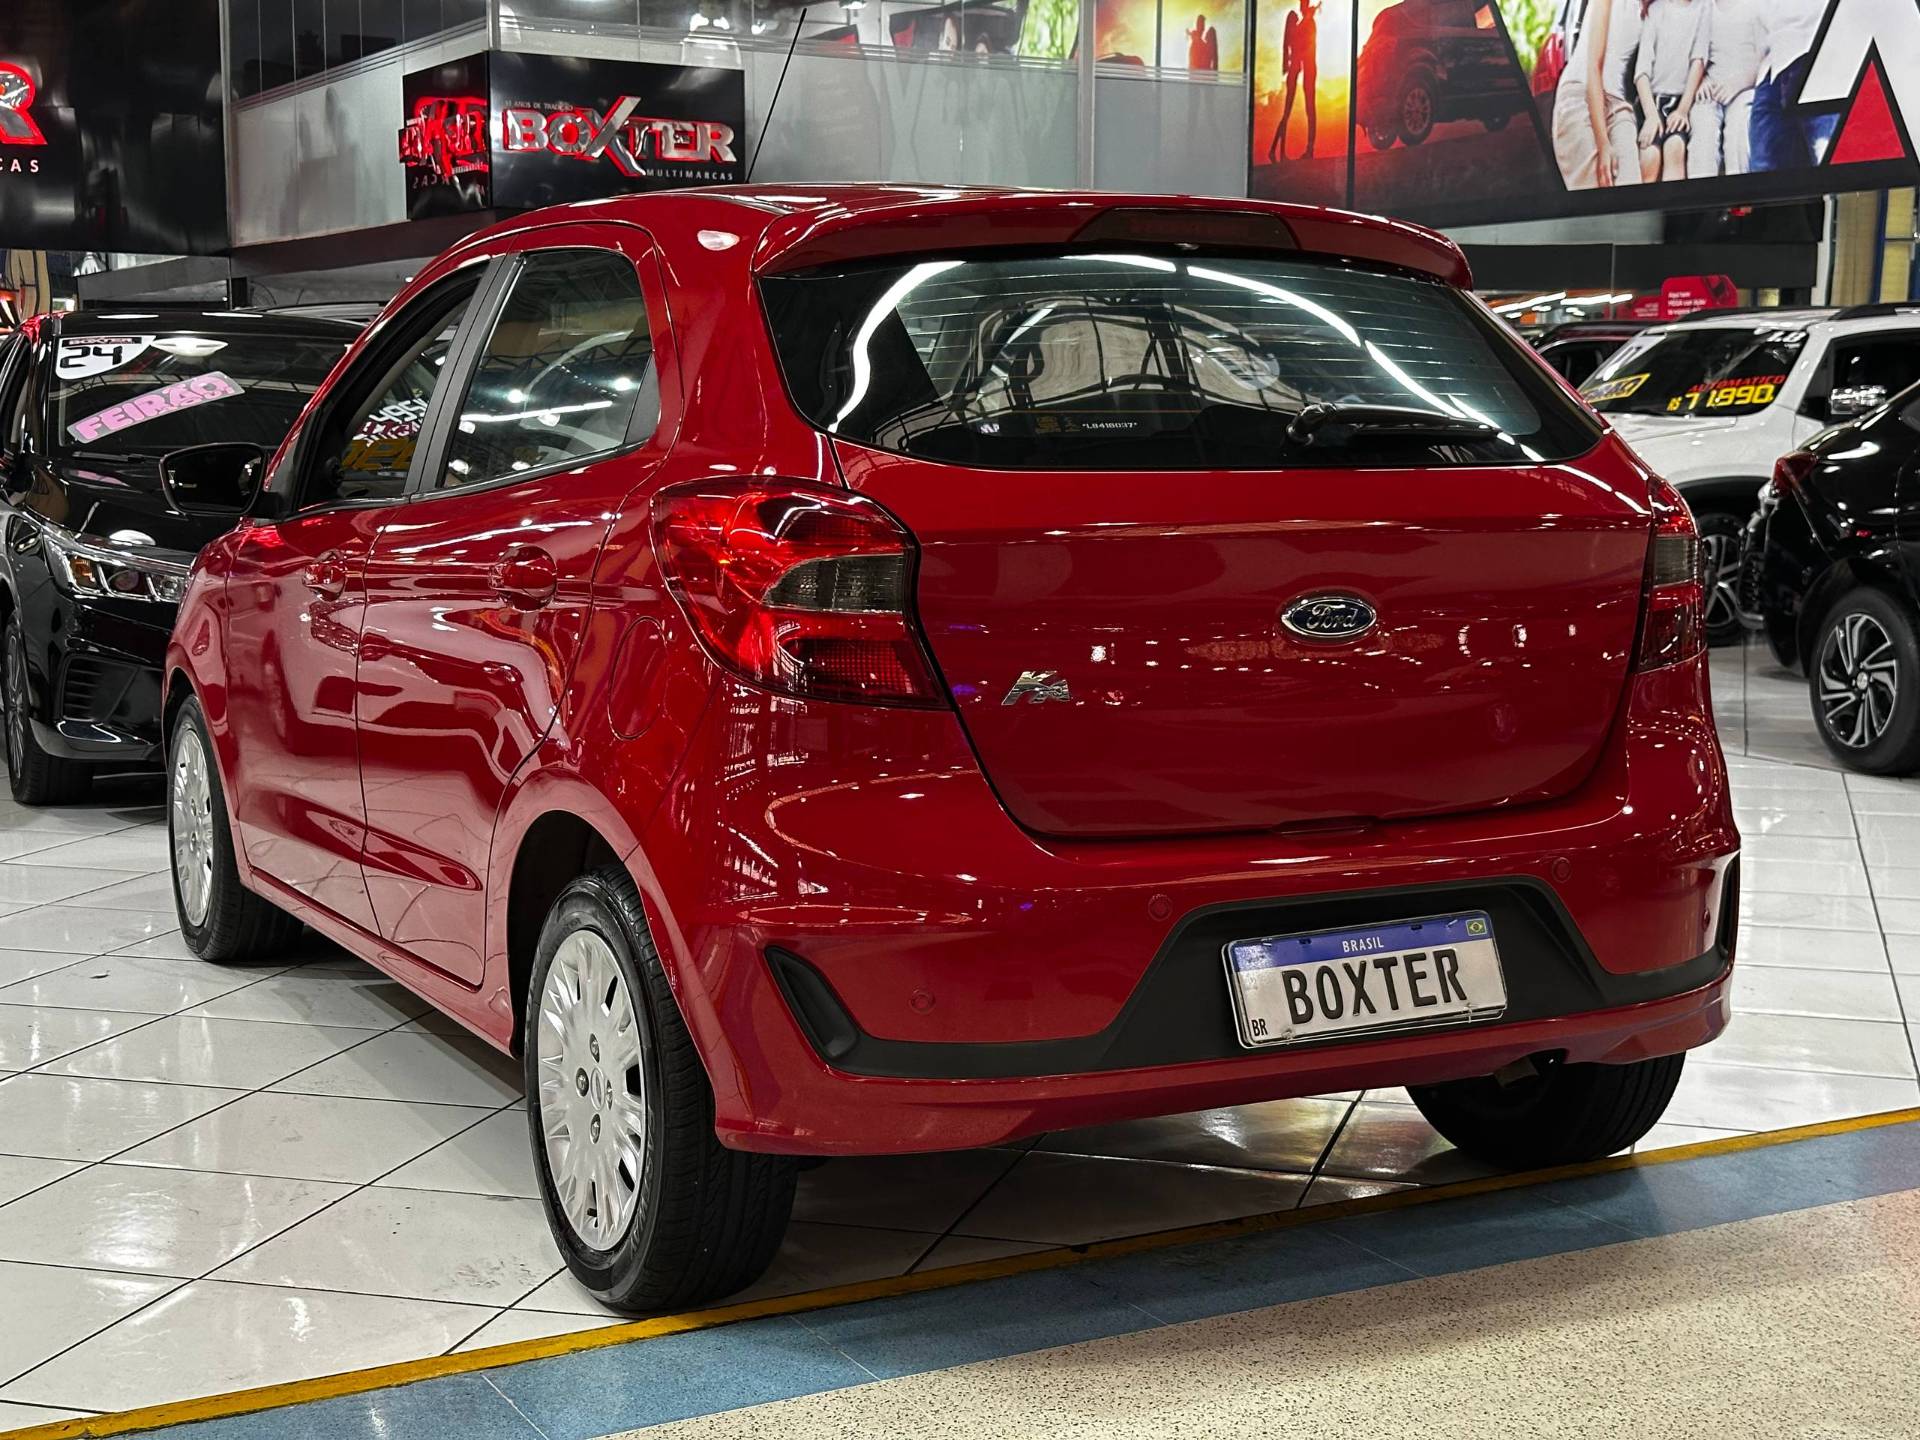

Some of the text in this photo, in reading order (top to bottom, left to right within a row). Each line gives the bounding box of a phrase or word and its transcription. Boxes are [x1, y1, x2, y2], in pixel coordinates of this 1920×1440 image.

[502, 96, 737, 176] BOXTER
[646, 168, 733, 181] MULTIMARCAS
[60, 345, 122, 368] 24
[76, 375, 235, 440] FEIRÃO
[1306, 603, 1359, 629] Ford
[1342, 936, 1384, 953] BRASIL
[1281, 947, 1467, 1025] BOXTER
[1251, 1018, 1268, 1037] BR
